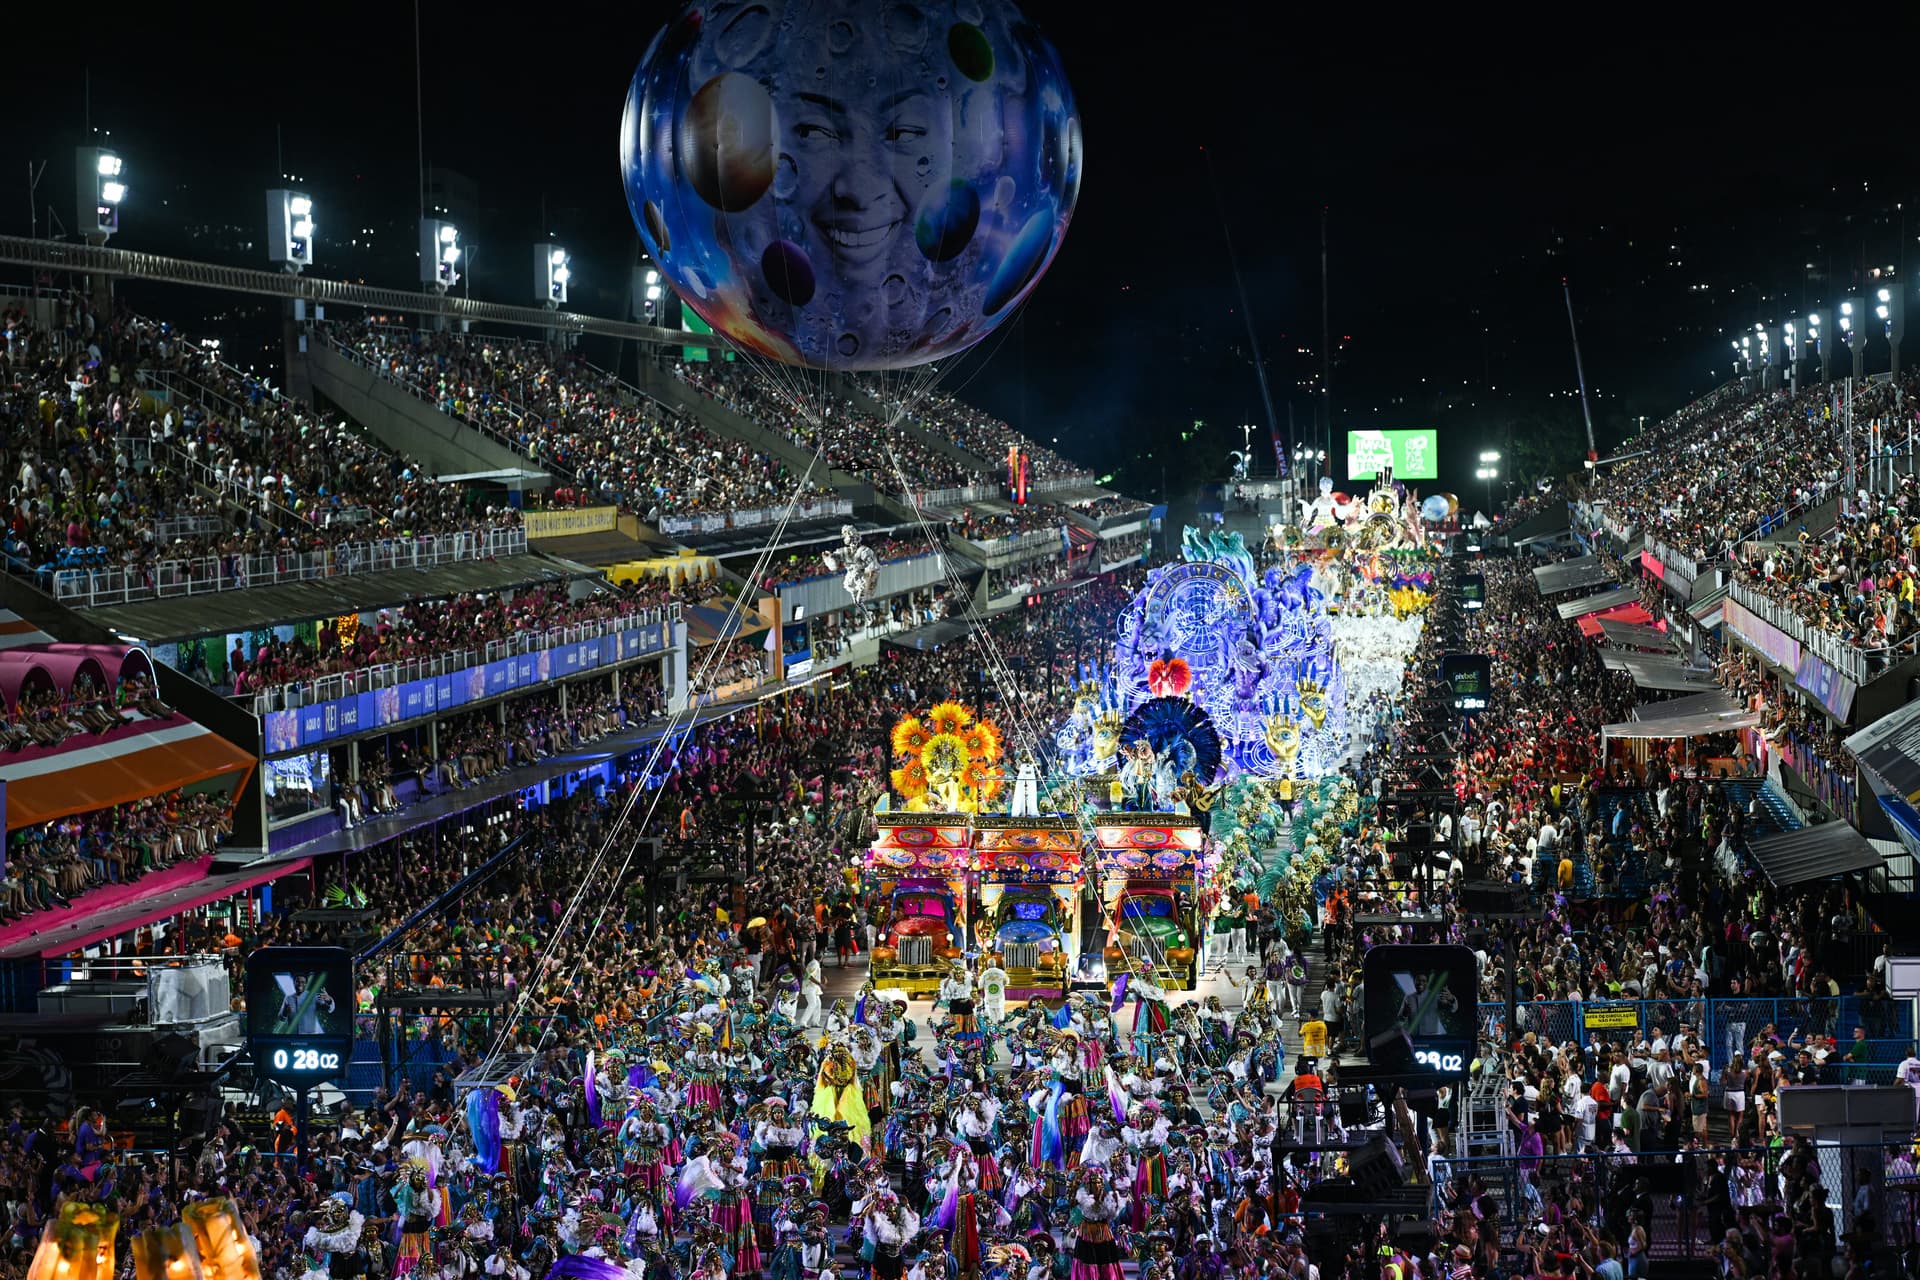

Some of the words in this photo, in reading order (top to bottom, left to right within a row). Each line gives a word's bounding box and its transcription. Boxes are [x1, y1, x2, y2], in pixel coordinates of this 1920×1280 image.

[424, 682, 435, 709] REI
[306, 717, 317, 731] AQUI
[325, 704, 337, 733] REI
[344, 707, 357, 725] VOCÊ
[274, 1049, 288, 1069] 0
